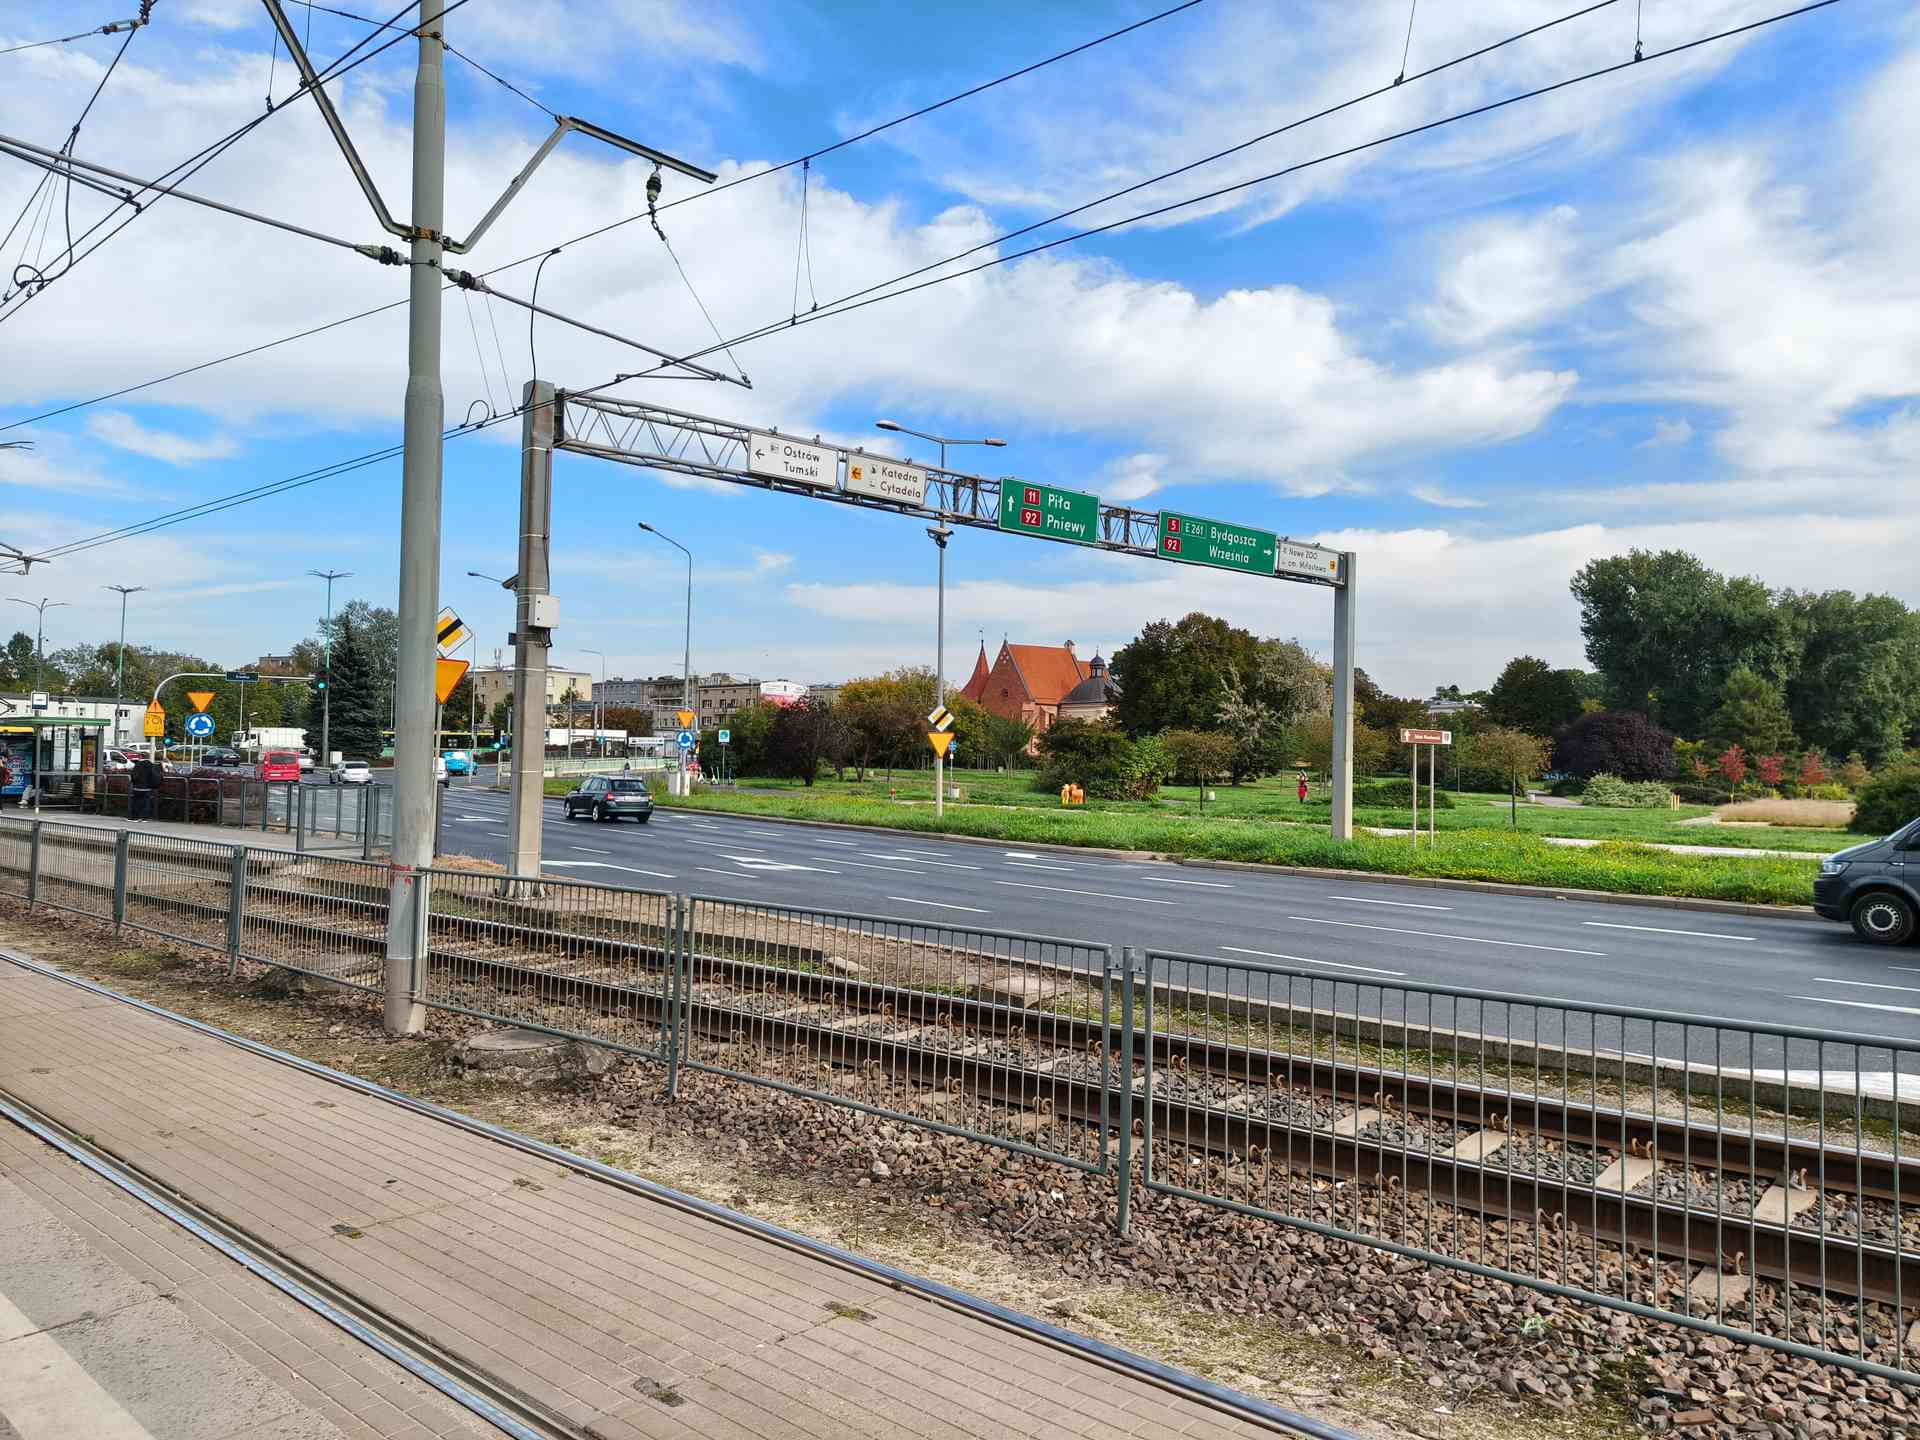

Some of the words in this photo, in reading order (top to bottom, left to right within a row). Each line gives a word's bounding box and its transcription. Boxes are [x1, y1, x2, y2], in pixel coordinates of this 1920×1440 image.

[783, 446, 820, 463] Ostrów
[784, 462, 819, 477] Tumski
[881, 465, 918, 483] Katedra
[880, 481, 921, 498] Cytadela
[1028, 491, 1036, 502] 11
[1024, 512, 1037, 524] 92
[1046, 514, 1086, 537] Pniewy
[1170, 520, 1176, 530] 5
[1191, 523, 1204, 536] 261
[1210, 526, 1257, 547] Bydgoszcz
[1167, 538, 1177, 550] 92
[1209, 545, 1249, 564] Września
